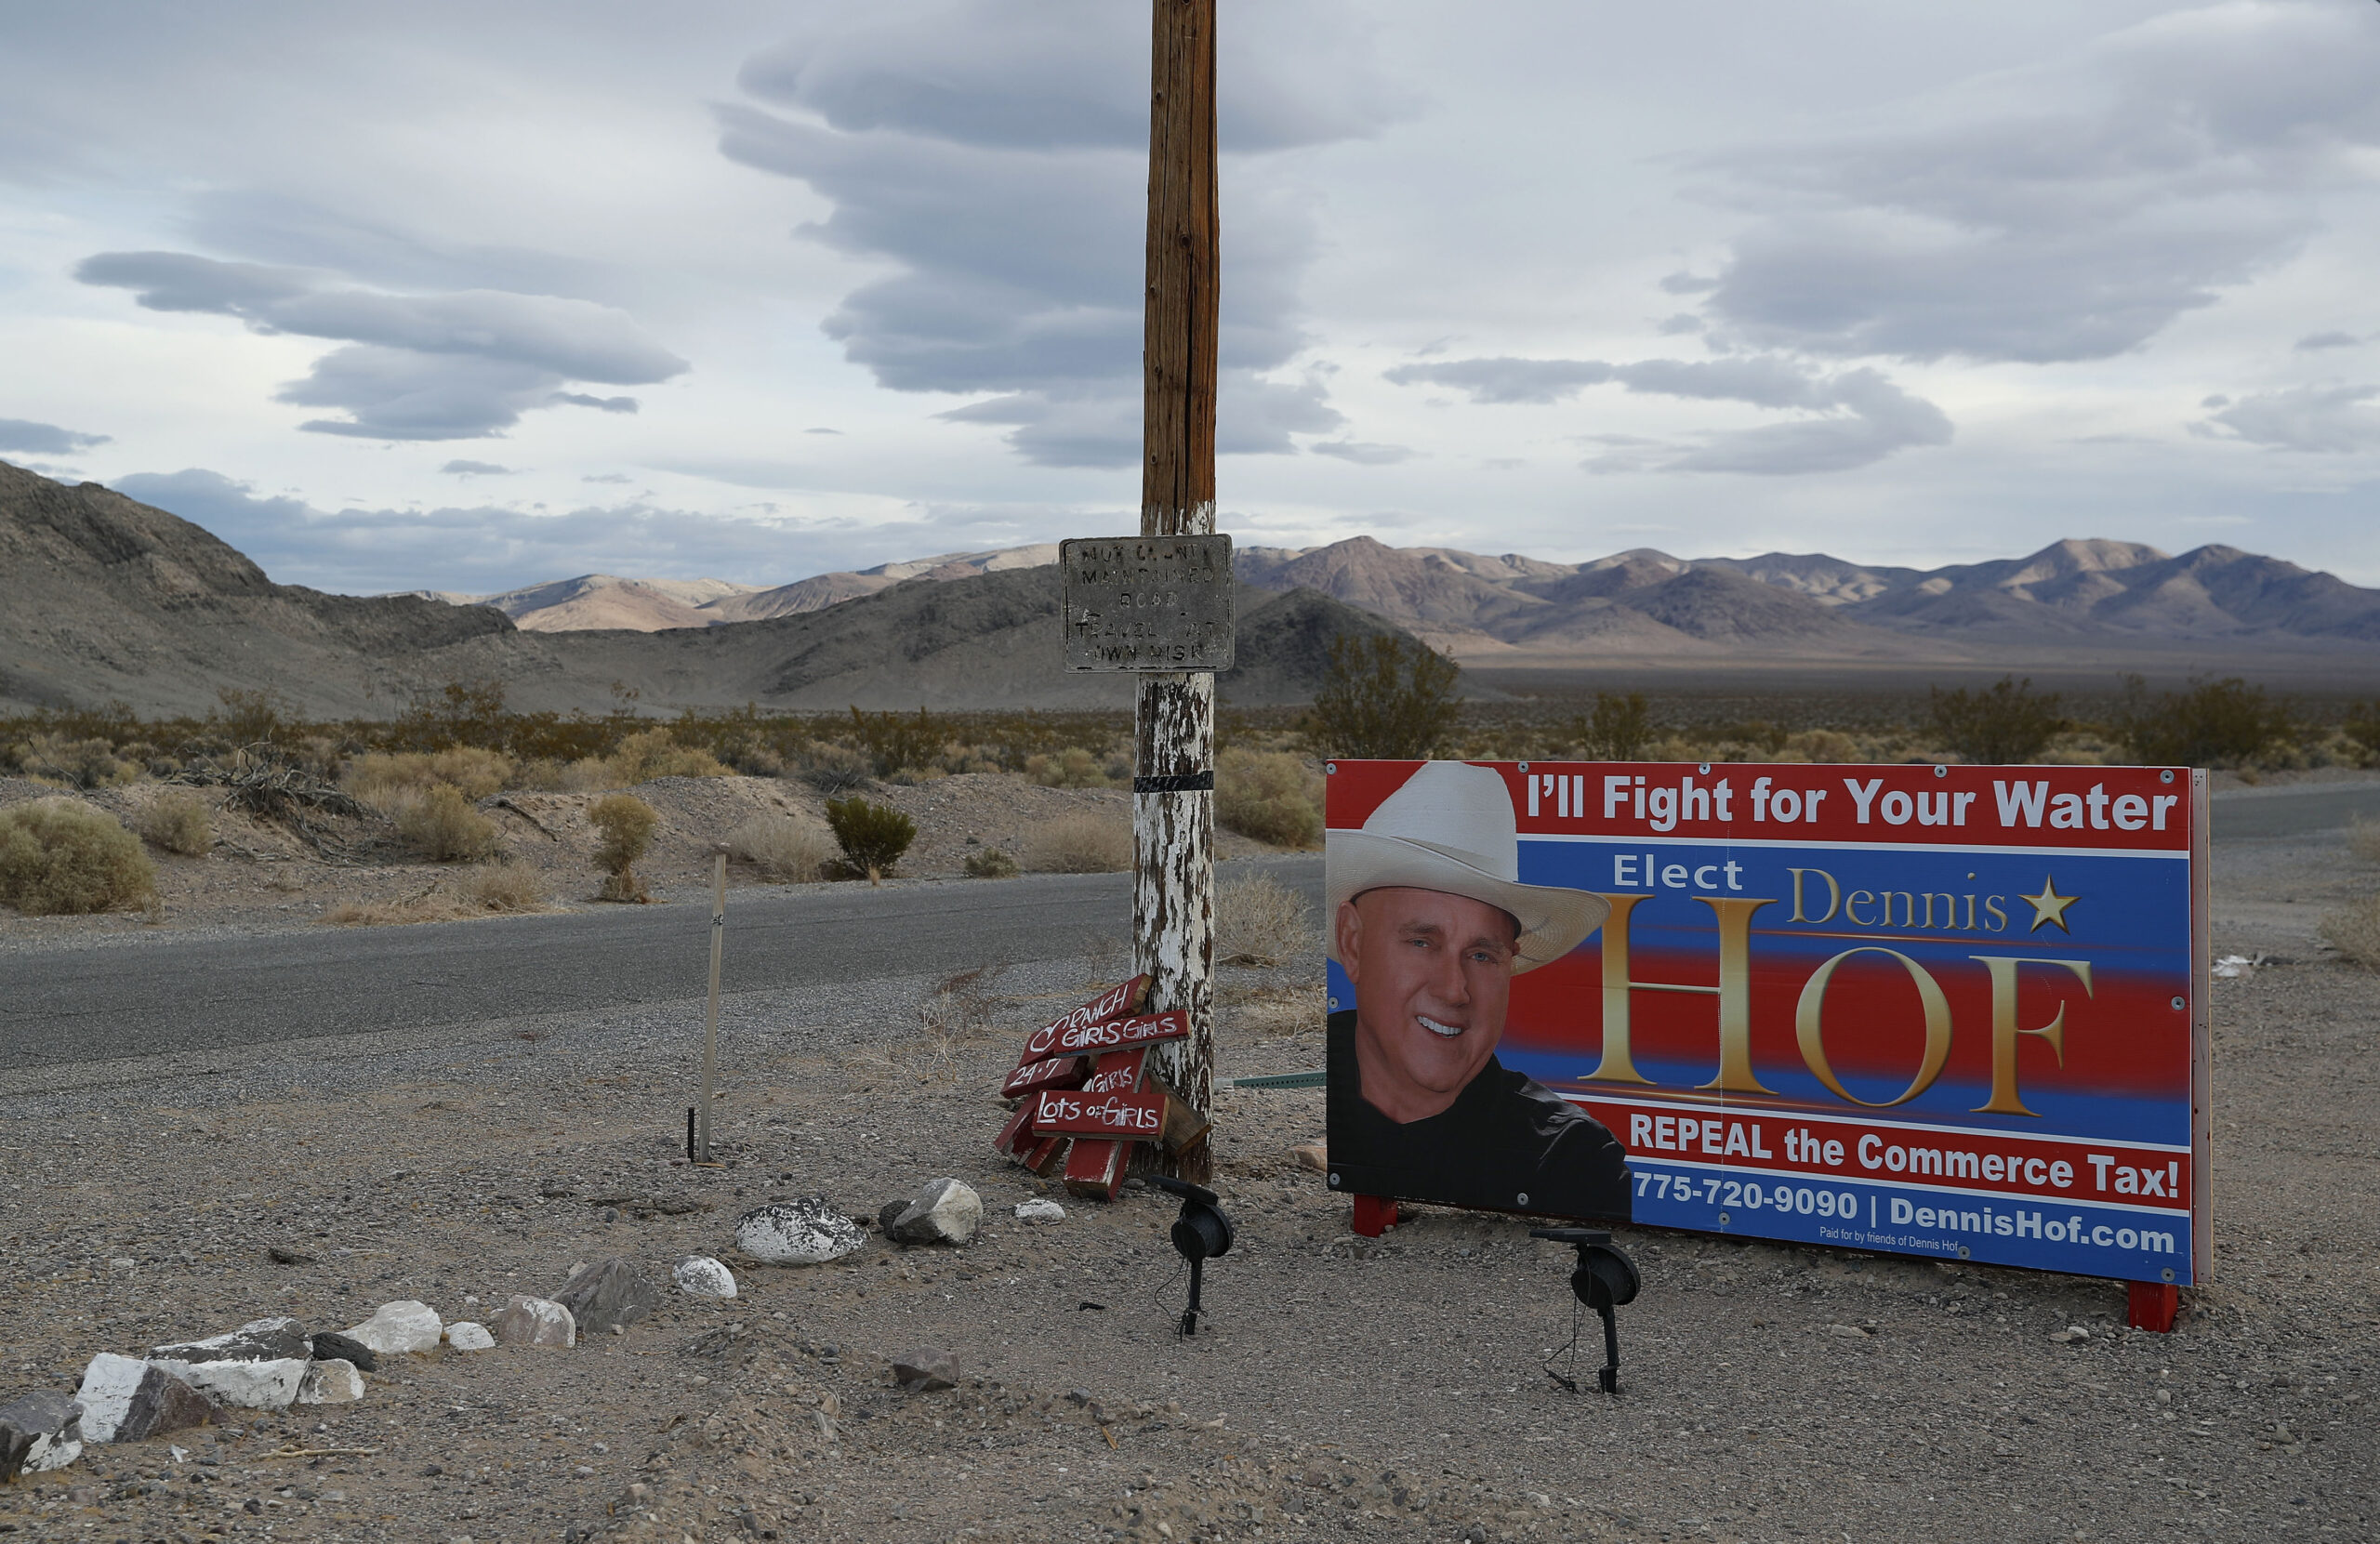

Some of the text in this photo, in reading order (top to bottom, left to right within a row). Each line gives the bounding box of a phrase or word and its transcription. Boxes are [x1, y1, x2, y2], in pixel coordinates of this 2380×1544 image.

[1082, 566, 1214, 586] MAINTAINED
[1119, 592, 1179, 609] ROAD
[1076, 620, 1219, 639] TRAVEL AT
[1150, 645, 1204, 661] RISK
[1527, 774, 2178, 832] I'll Fight for Your Water
[1614, 854, 2009, 932] Elect Dennis
[1577, 892, 2094, 1117] HOF
[1630, 1113, 2179, 1199] REPEAL the Commerce Tax!
[1633, 1171, 1858, 1220] 775-720-9090
[1890, 1197, 2175, 1254] DennisHof.com
[1819, 1226, 1959, 1252] Paid for by friends of Dennis Hof
